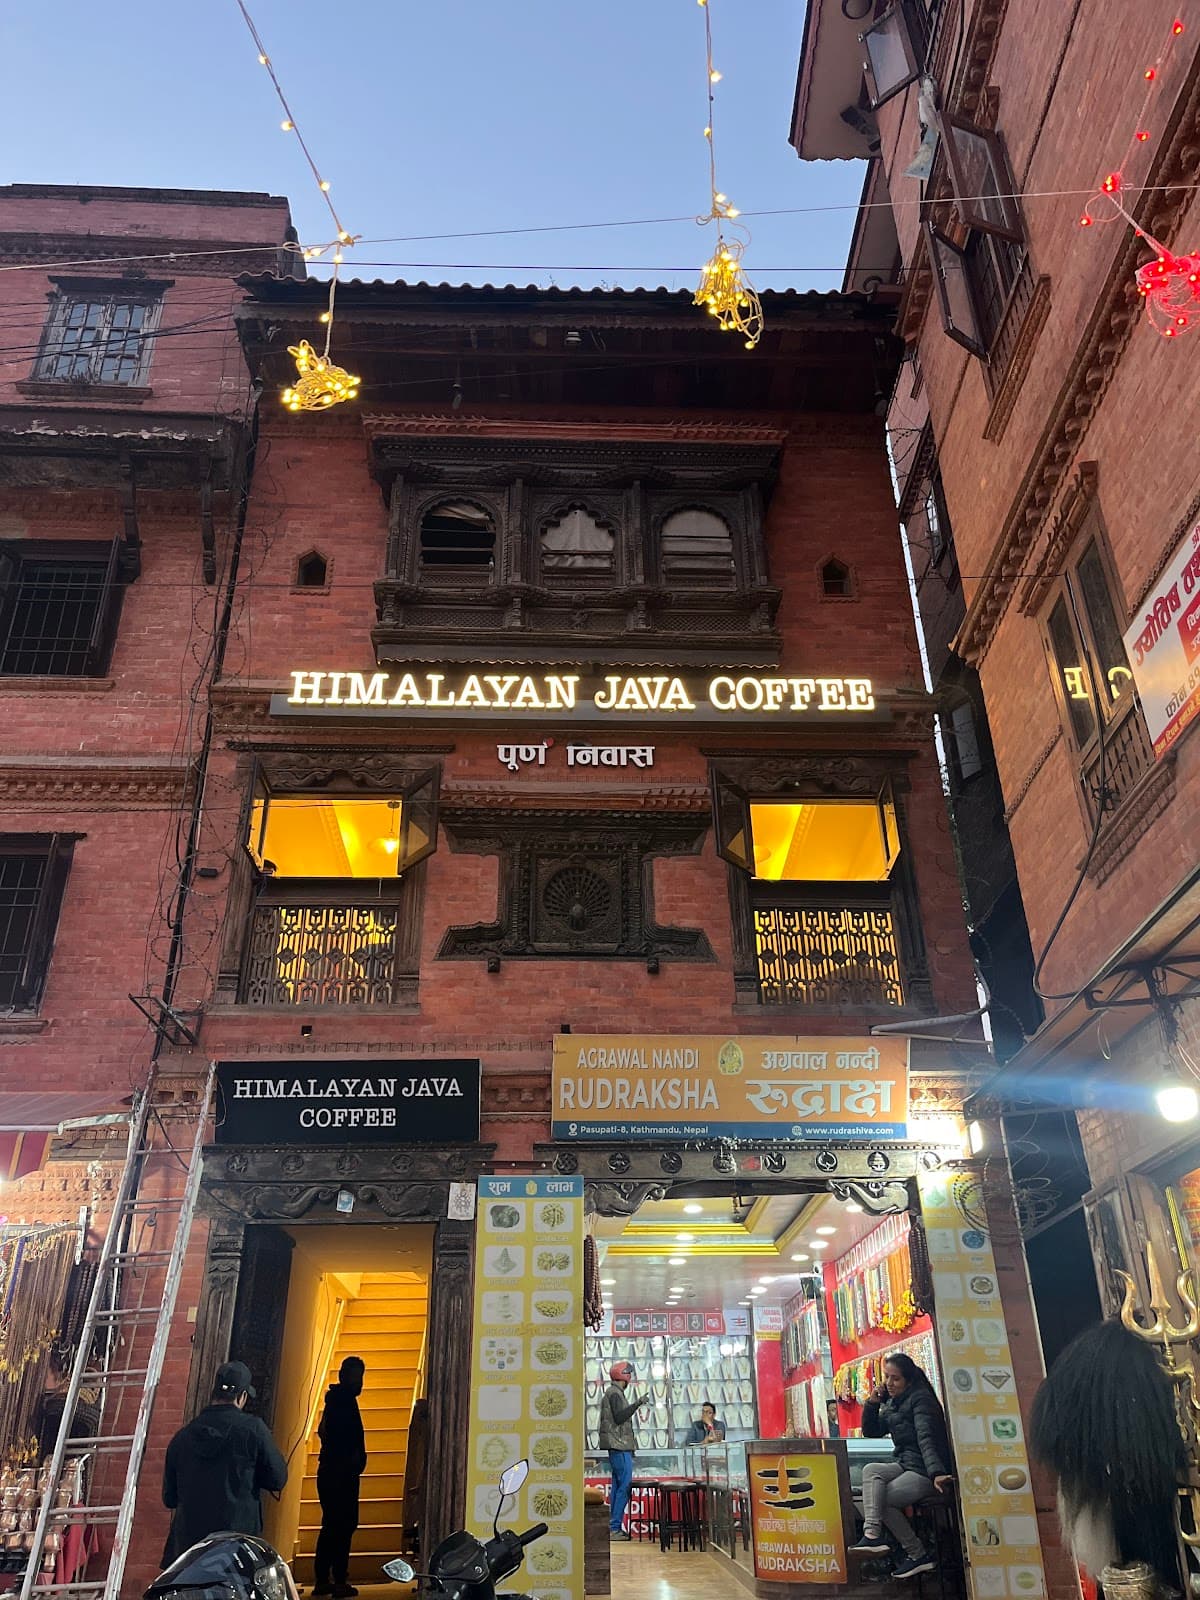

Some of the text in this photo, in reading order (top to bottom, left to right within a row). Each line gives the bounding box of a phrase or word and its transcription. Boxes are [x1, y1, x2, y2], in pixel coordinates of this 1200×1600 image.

[287, 671, 875, 713] HIMALAYAN JAVA COFFEE
[566, 745, 655, 768] निवास
[577, 1047, 700, 1070] AGRAWAL NANDI
[761, 1046, 881, 1073] अग्रवाल नन्दी
[233, 1078, 464, 1099] HIMALAYAN JAVA
[559, 1078, 721, 1111] RUDRAKSHA
[299, 1107, 397, 1129] COFFEE
[631, 1126, 682, 1136] Kathmandu,
[684, 1126, 709, 1136] Nepal
[805, 1126, 894, 1136] www.rudrashiva.com
[488, 1181, 574, 1195] शुभ लाभ
[758, 1542, 836, 1556] AGRAWAL NANDI
[758, 1556, 841, 1573] RUDRAKSHA
